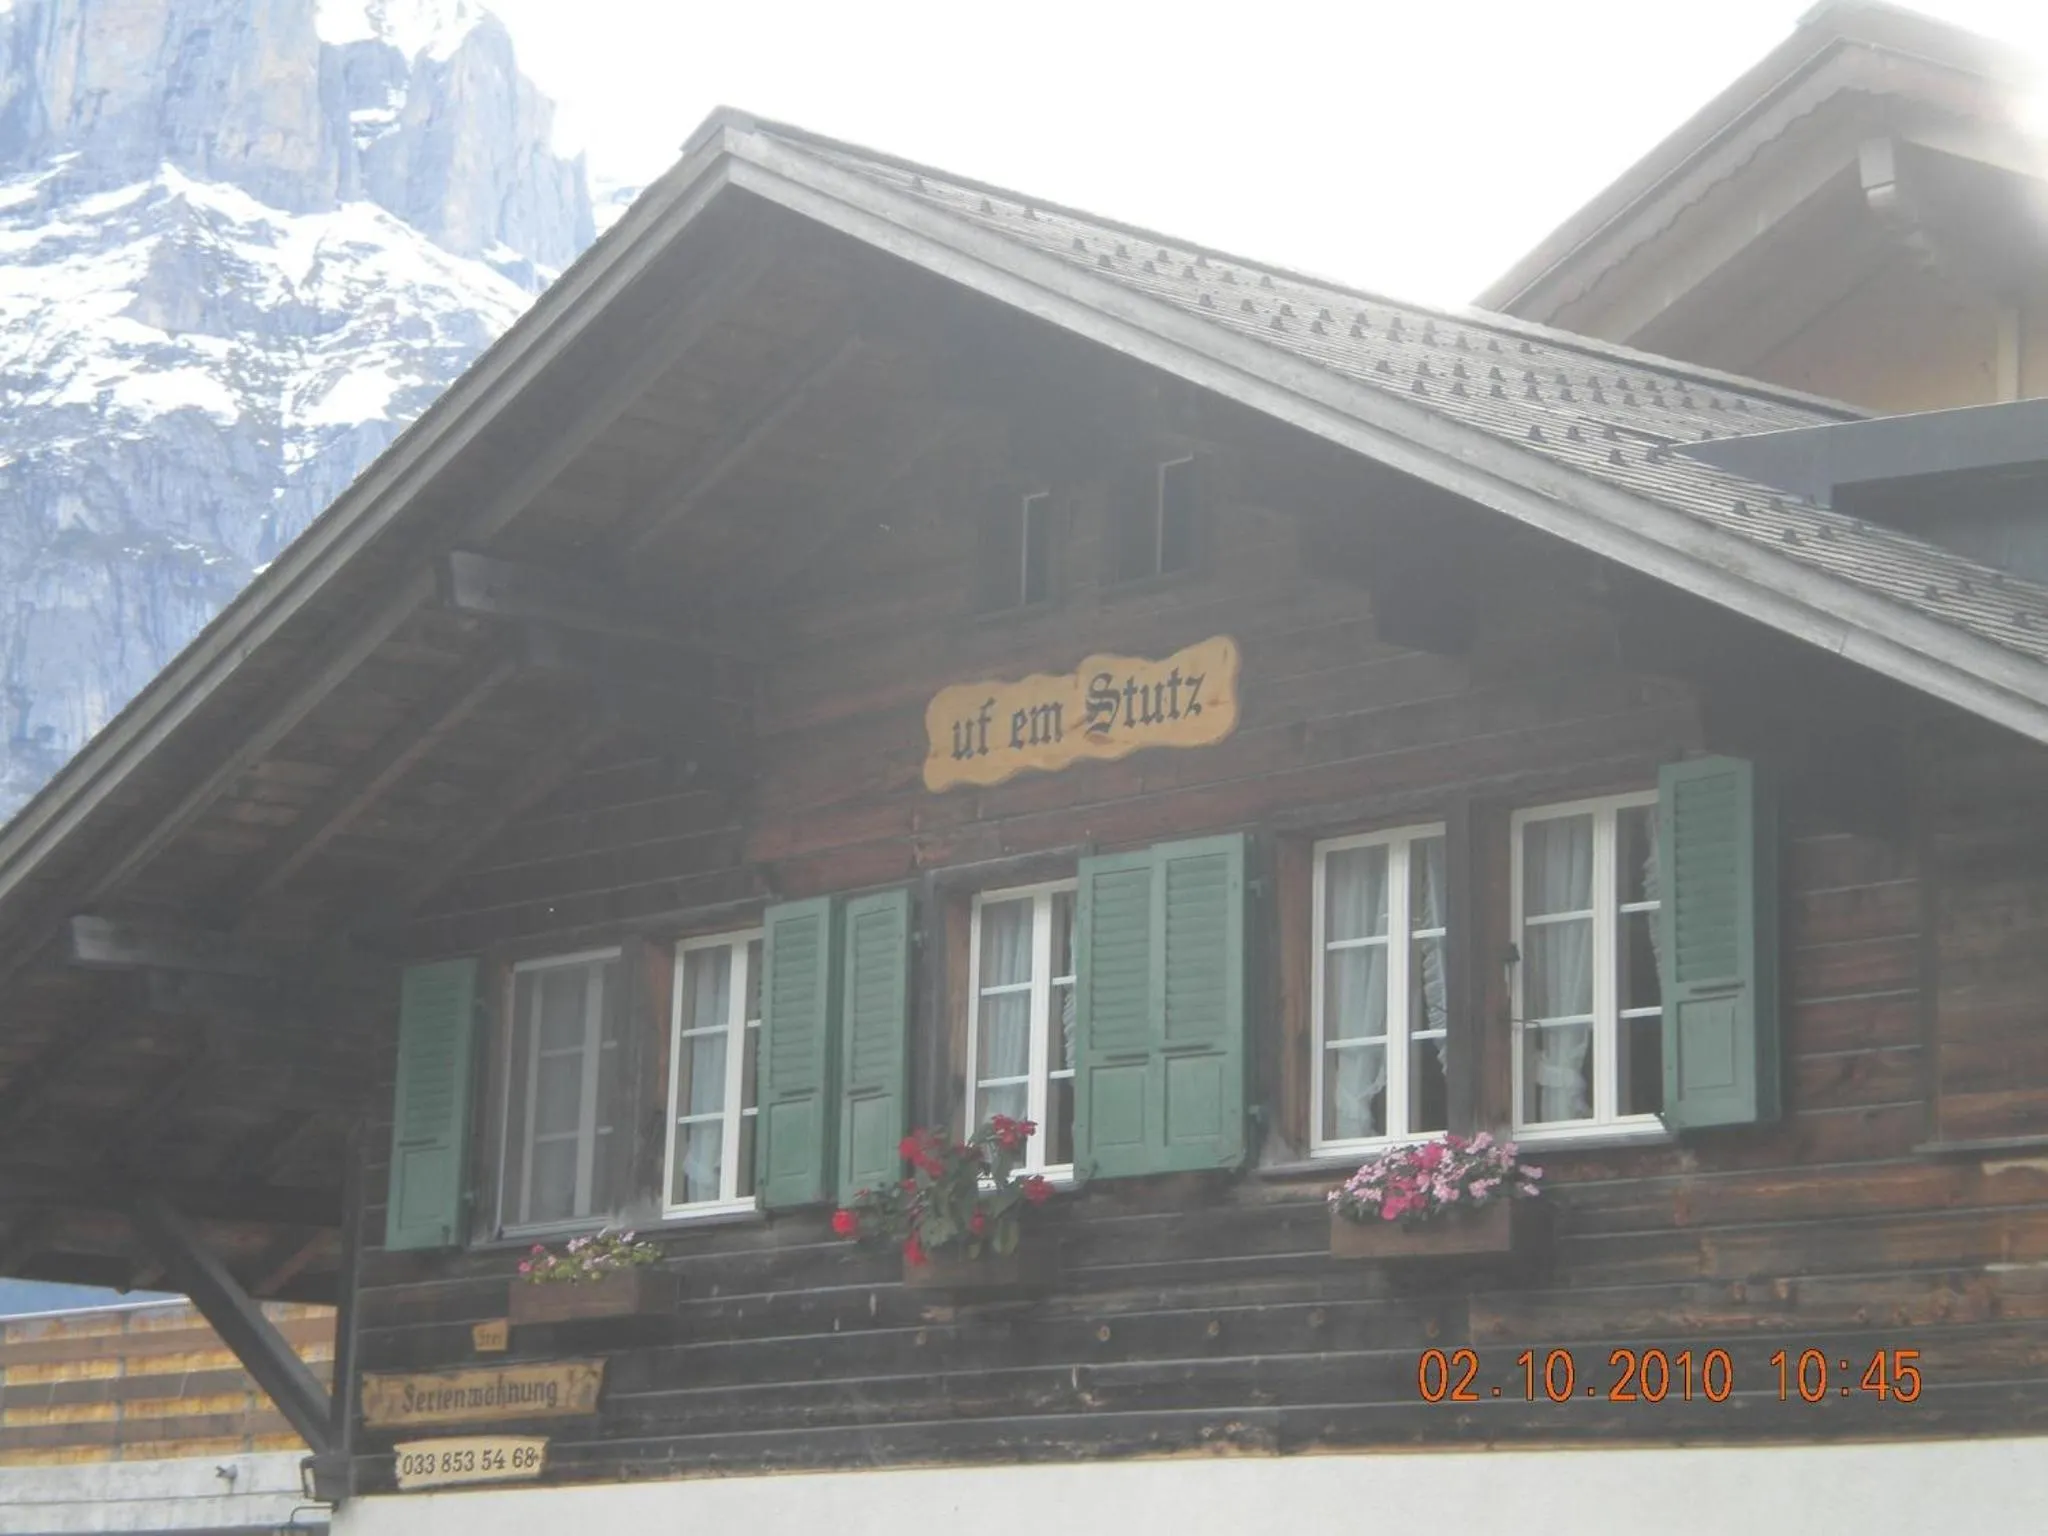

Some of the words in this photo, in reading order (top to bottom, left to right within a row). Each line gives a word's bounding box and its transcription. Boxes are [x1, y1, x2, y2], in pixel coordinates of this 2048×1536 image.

[952, 697, 996, 760] uf
[1008, 701, 1064, 750] em
[1084, 666, 1206, 735] Stutz
[403, 1454, 436, 1475] 033
[441, 1451, 475, 1472] 853
[481, 1448, 506, 1470] 54
[512, 1446, 537, 1468] 68
